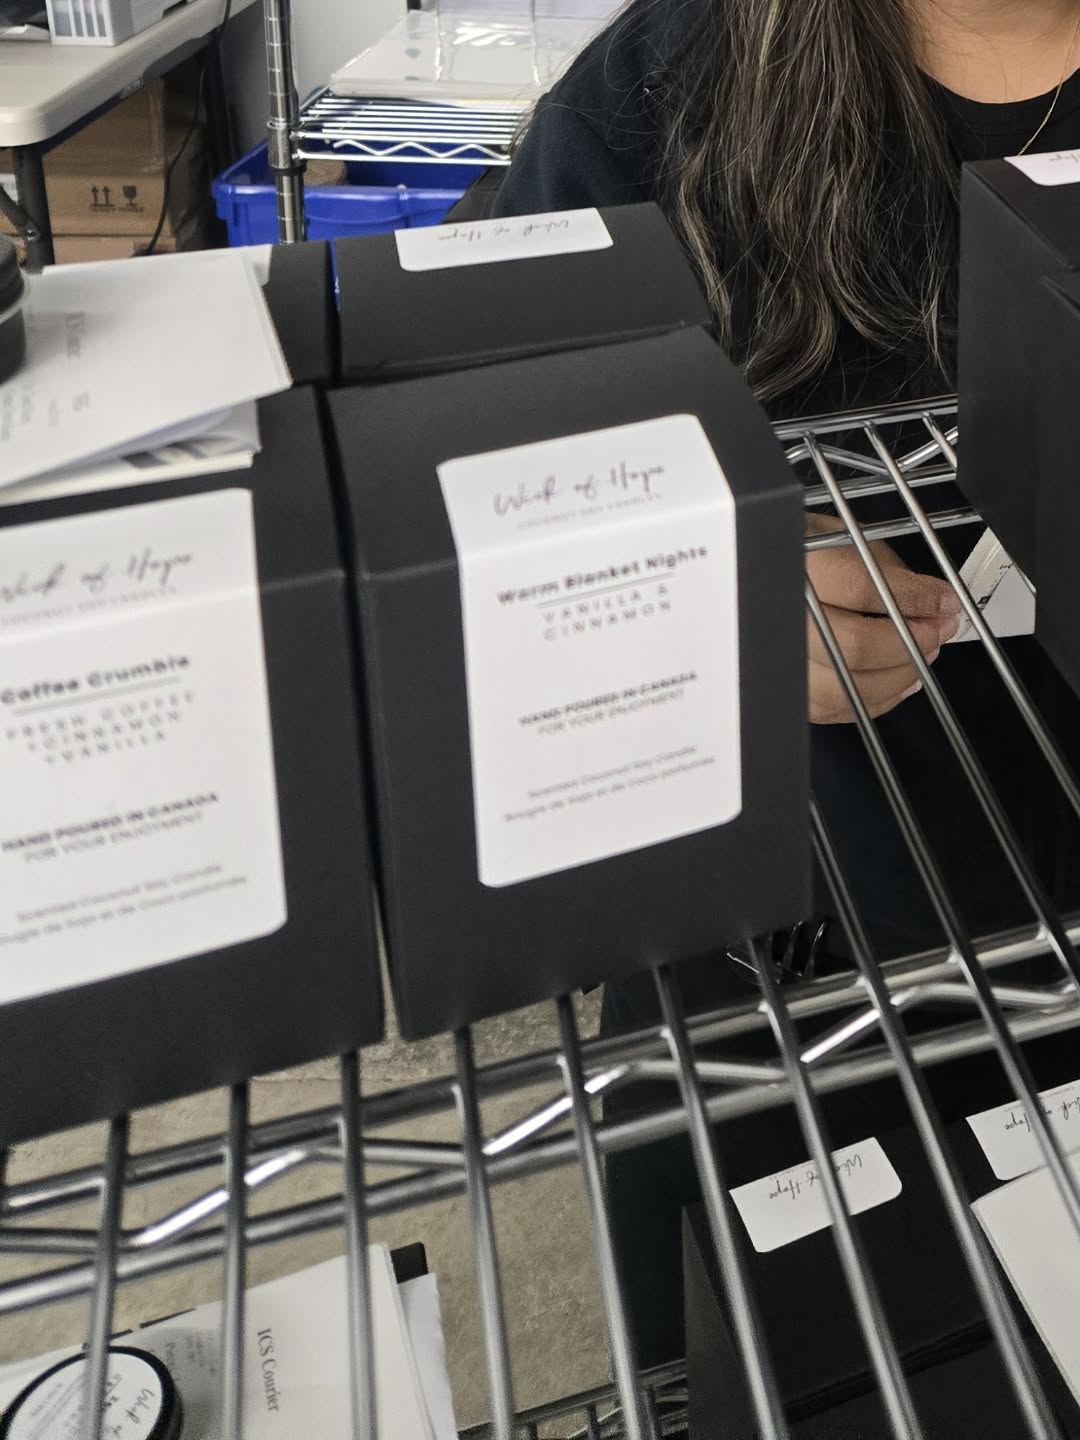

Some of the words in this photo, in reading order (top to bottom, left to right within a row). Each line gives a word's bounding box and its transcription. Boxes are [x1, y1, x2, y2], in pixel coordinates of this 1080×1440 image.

[493, 475, 557, 516] Wick
[572, 473, 597, 500] of
[608, 460, 665, 493] Hope
[496, 581, 560, 607] Warm
[564, 561, 640, 590] Blanket
[644, 545, 708, 574] Nights
[0, 679, 79, 705] Coffee
[86, 655, 190, 689] Crumble
[769, 1178, 802, 1200] Hope
[834, 1153, 863, 1177] Wic
[256, 1327, 273, 1357] ICS
[260, 1359, 280, 1412] Courier
